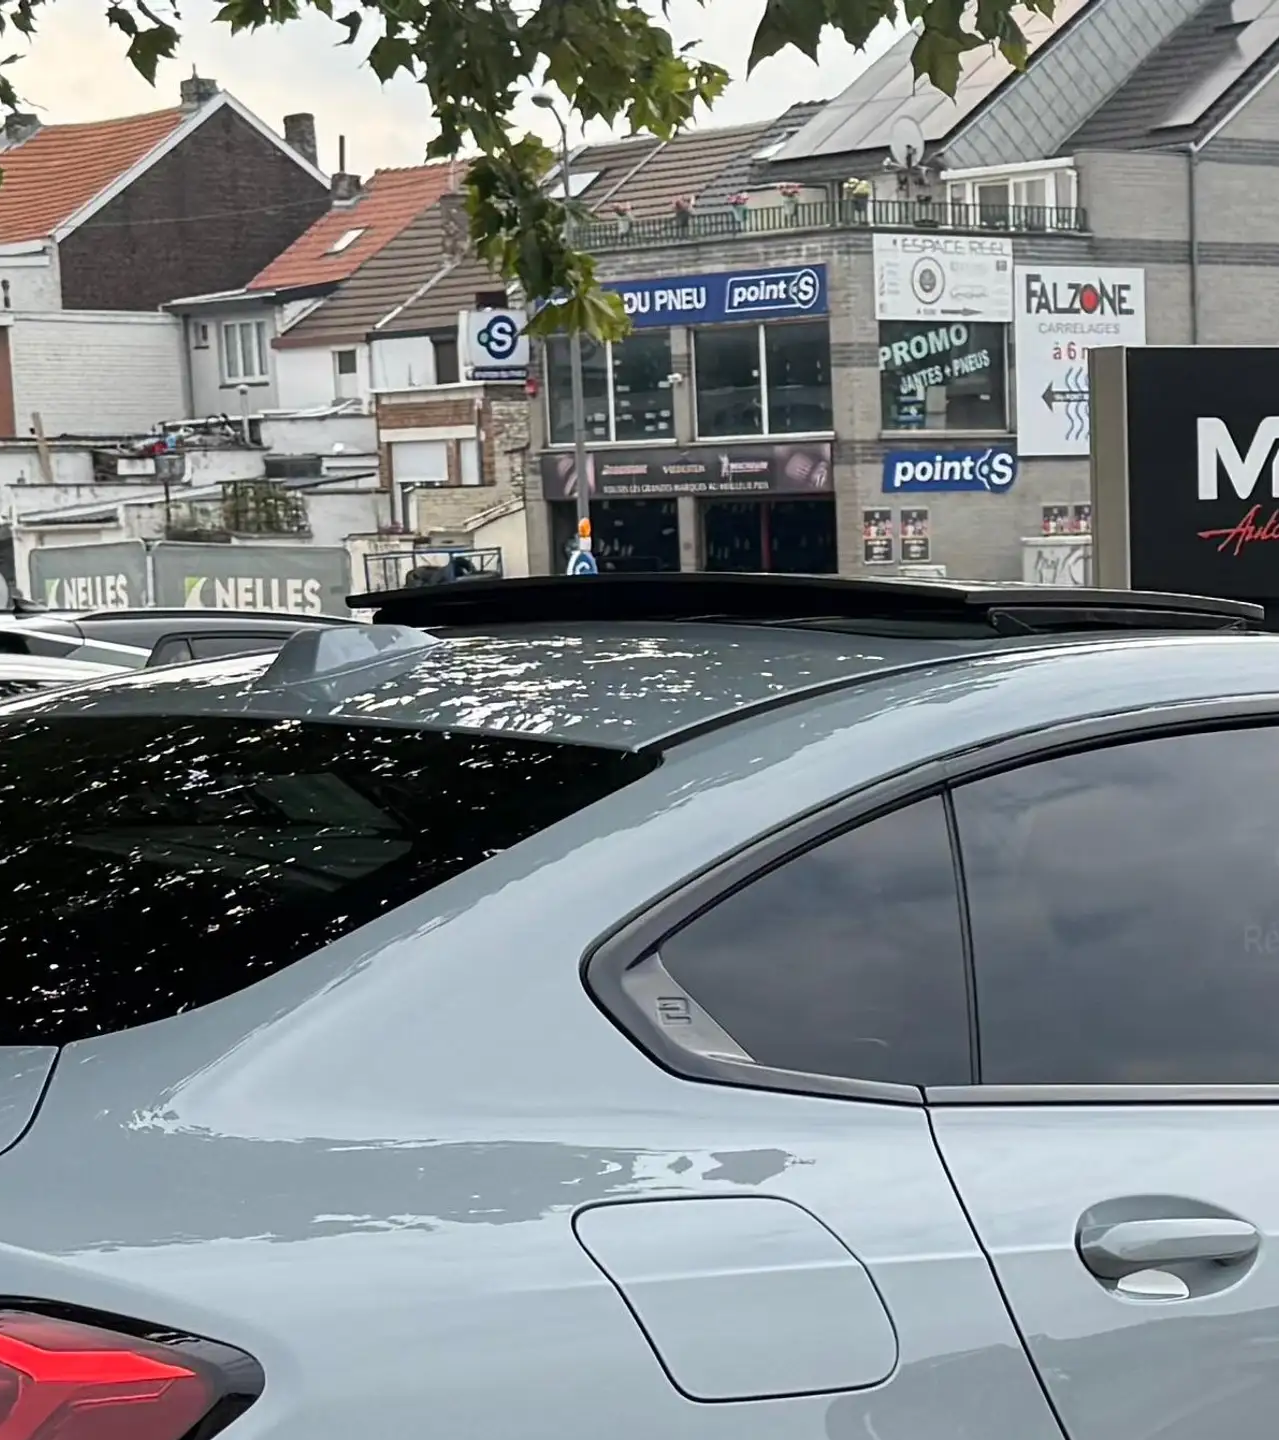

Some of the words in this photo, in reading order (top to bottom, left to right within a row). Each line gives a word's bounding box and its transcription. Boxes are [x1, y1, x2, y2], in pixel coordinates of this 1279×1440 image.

[623, 293, 650, 313] DU
[654, 287, 706, 312] PNEU
[732, 284, 787, 304] point
[1026, 273, 1135, 317] FALZONE
[1038, 322, 1121, 335] CARRELAGES
[879, 323, 968, 371] PROMO
[1067, 341, 1077, 360] 6
[900, 365, 943, 394] JANTES
[952, 349, 991, 377] PNEUS
[893, 455, 975, 487] point
[62, 573, 129, 609] NELLES
[214, 577, 323, 614] NELLES
